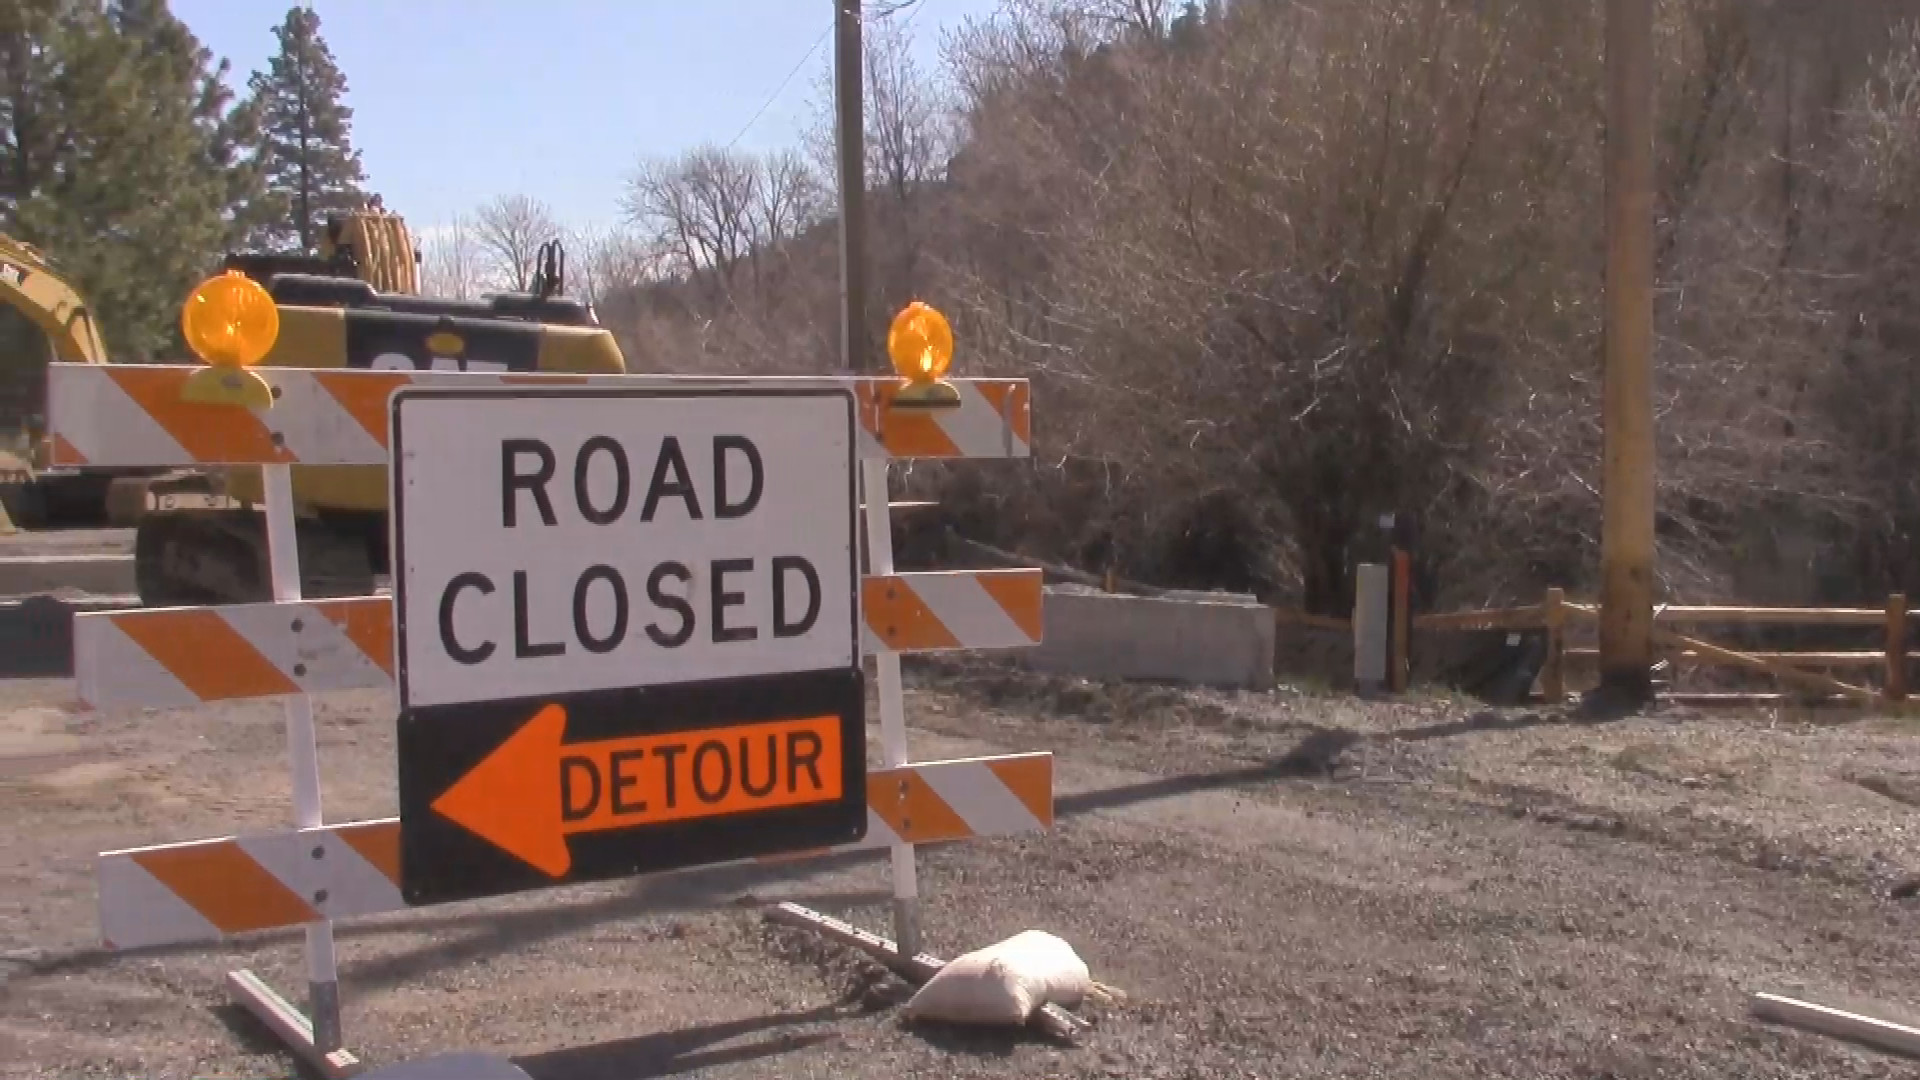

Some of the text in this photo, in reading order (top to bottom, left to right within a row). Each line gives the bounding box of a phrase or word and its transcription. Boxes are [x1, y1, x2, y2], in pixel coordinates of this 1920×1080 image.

[502, 435, 764, 528] ROAD
[438, 555, 822, 665] CLOSED
[559, 730, 823, 823] DETOUR
